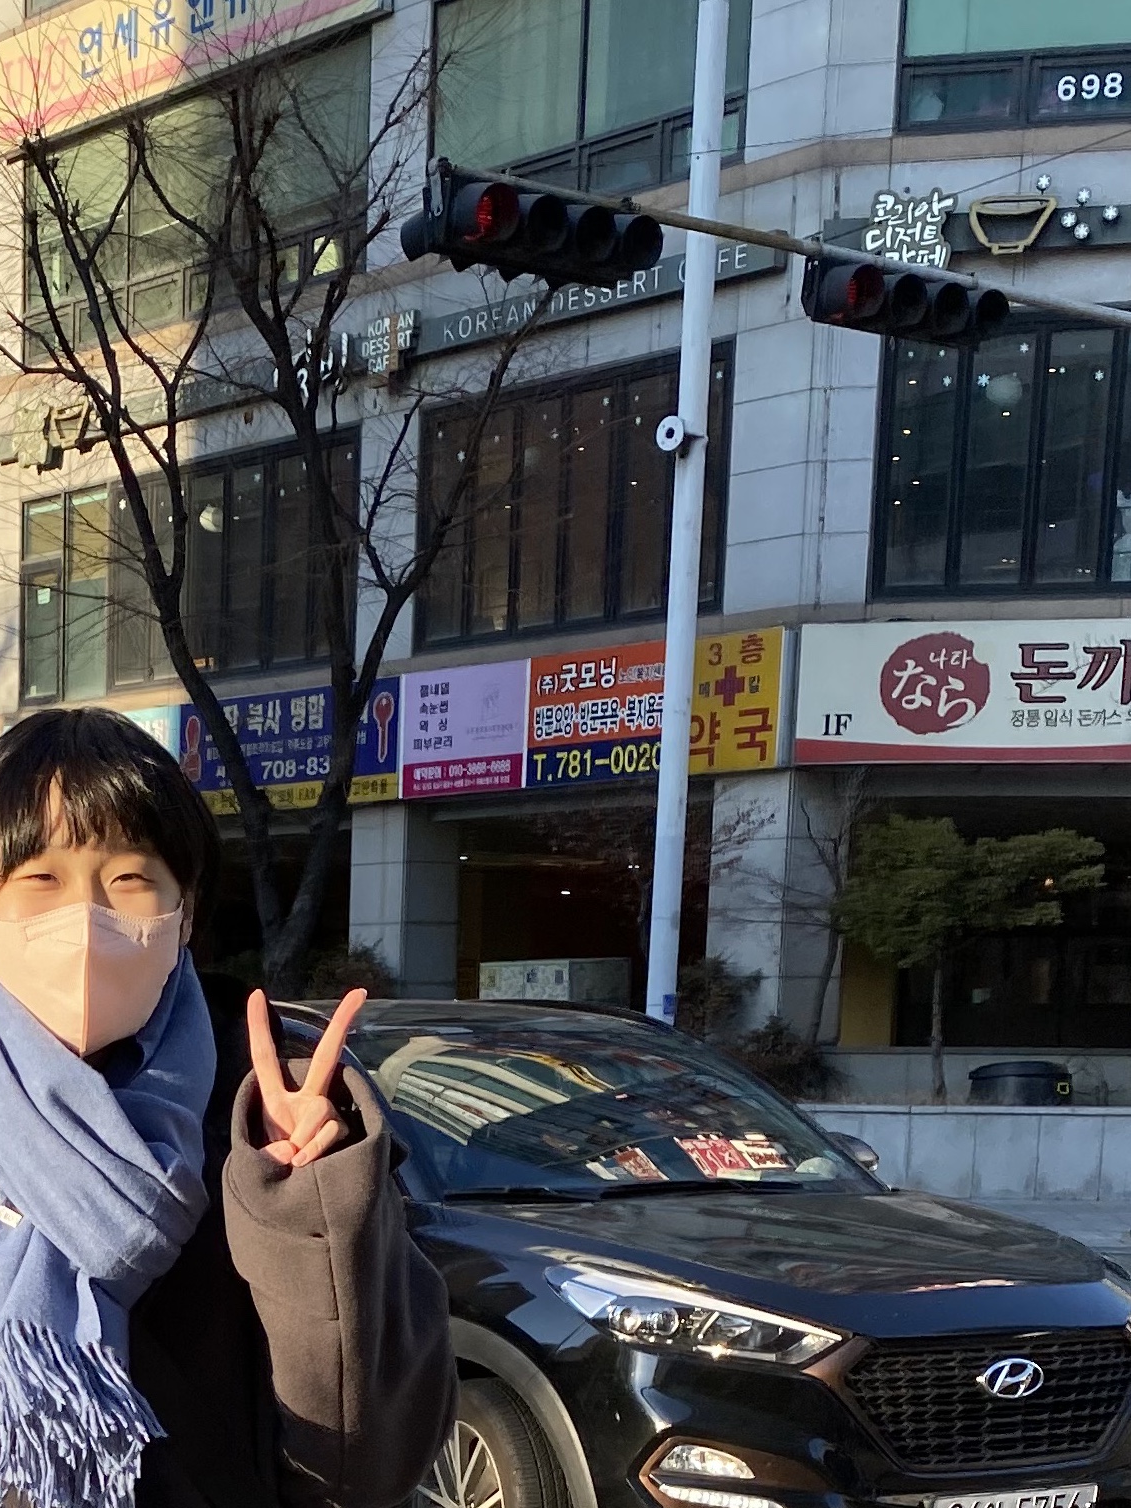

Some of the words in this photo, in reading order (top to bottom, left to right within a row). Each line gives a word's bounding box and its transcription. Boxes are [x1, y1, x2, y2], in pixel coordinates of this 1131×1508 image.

[1056, 72, 1123, 101] 698
[874, 192, 954, 224] 코리안
[865, 221, 939, 250] 디저트
[443, 299, 537, 342] KOREAN
[678, 243, 748, 284] CFE
[929, 648, 972, 669] 나라
[891, 659, 977, 728] なら
[822, 713, 853, 736] 1F
[1077, 708, 1123, 727] 돈까스
[689, 707, 773, 767] 약국
